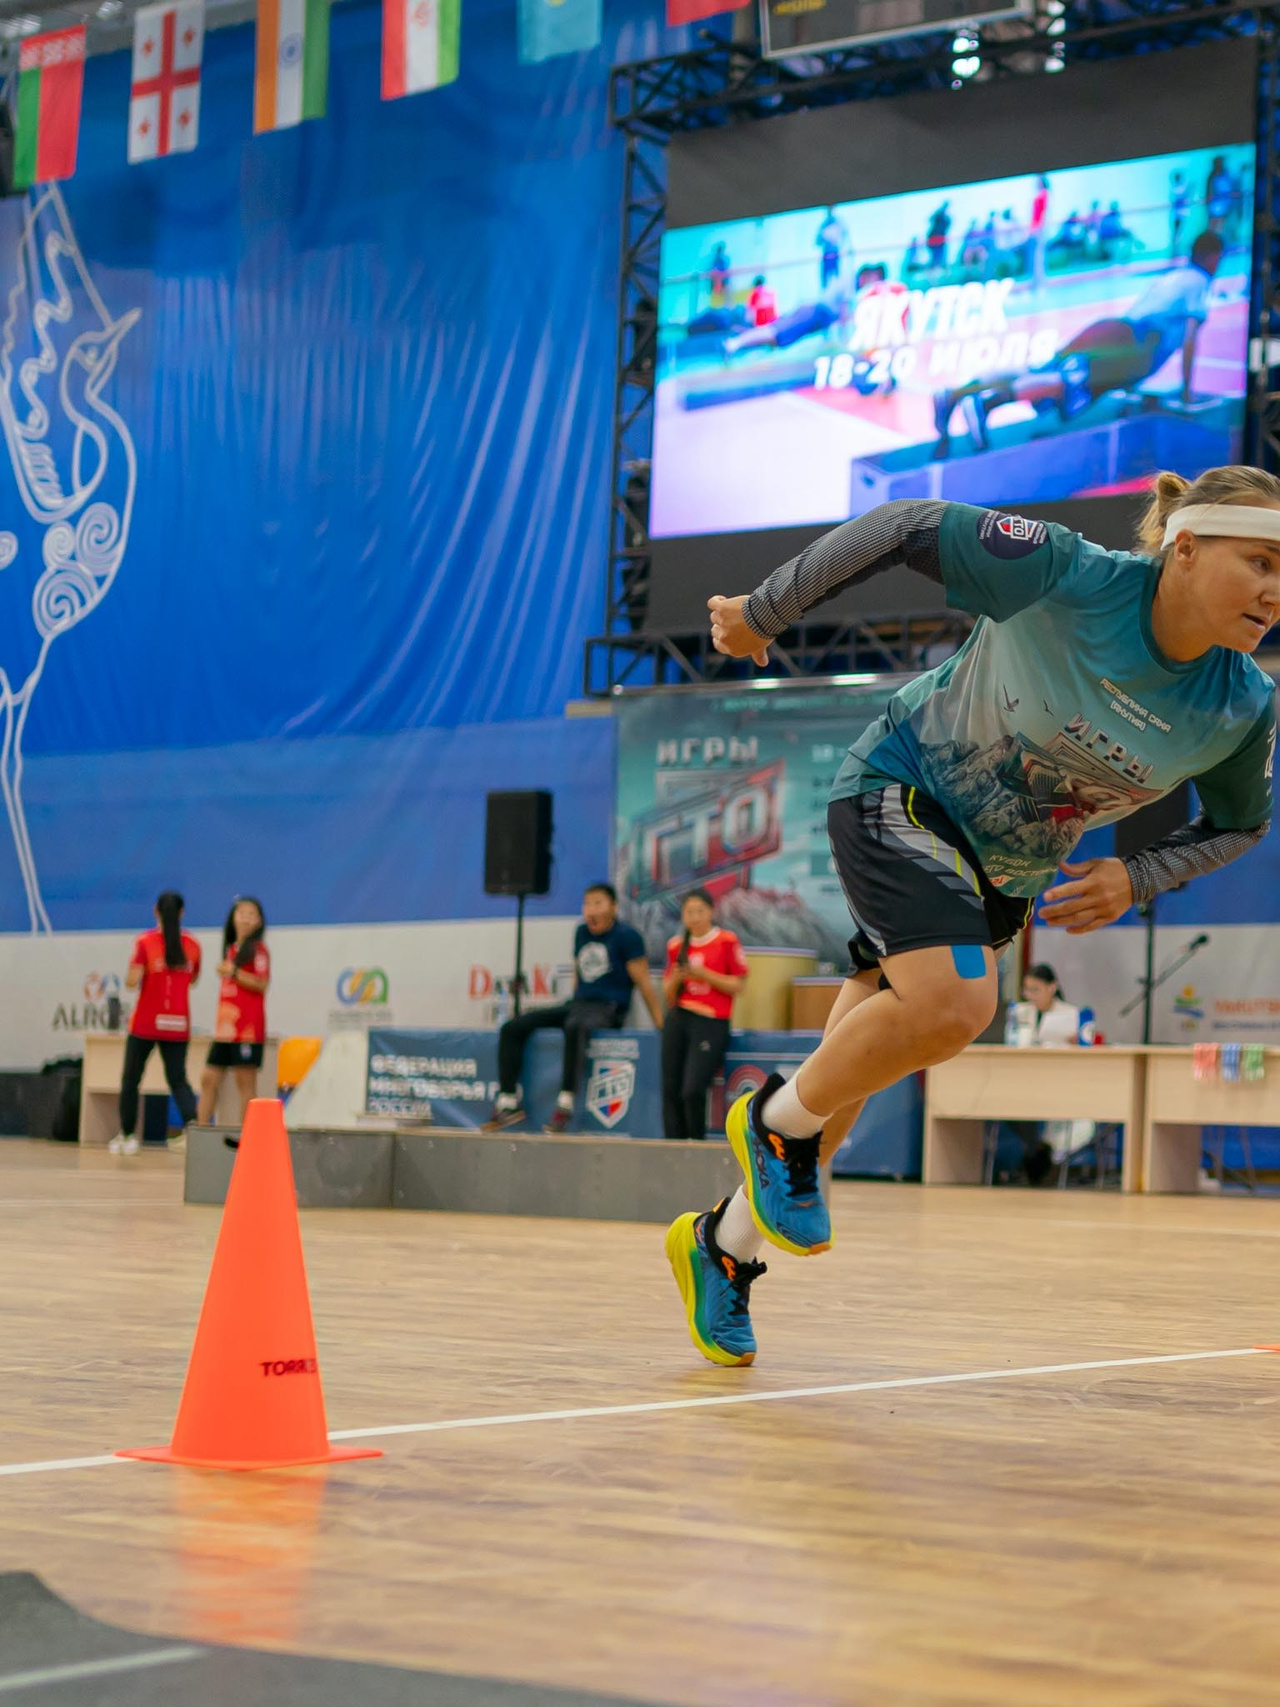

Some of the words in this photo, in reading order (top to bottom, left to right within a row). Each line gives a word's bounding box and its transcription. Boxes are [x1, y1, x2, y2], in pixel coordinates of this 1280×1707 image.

[848, 278, 1014, 351] ЯКУТСК
[813, 346, 918, 391] 18-20
[656, 736, 759, 764] ИГРЫ
[1064, 712, 1154, 784] ИГРЫ
